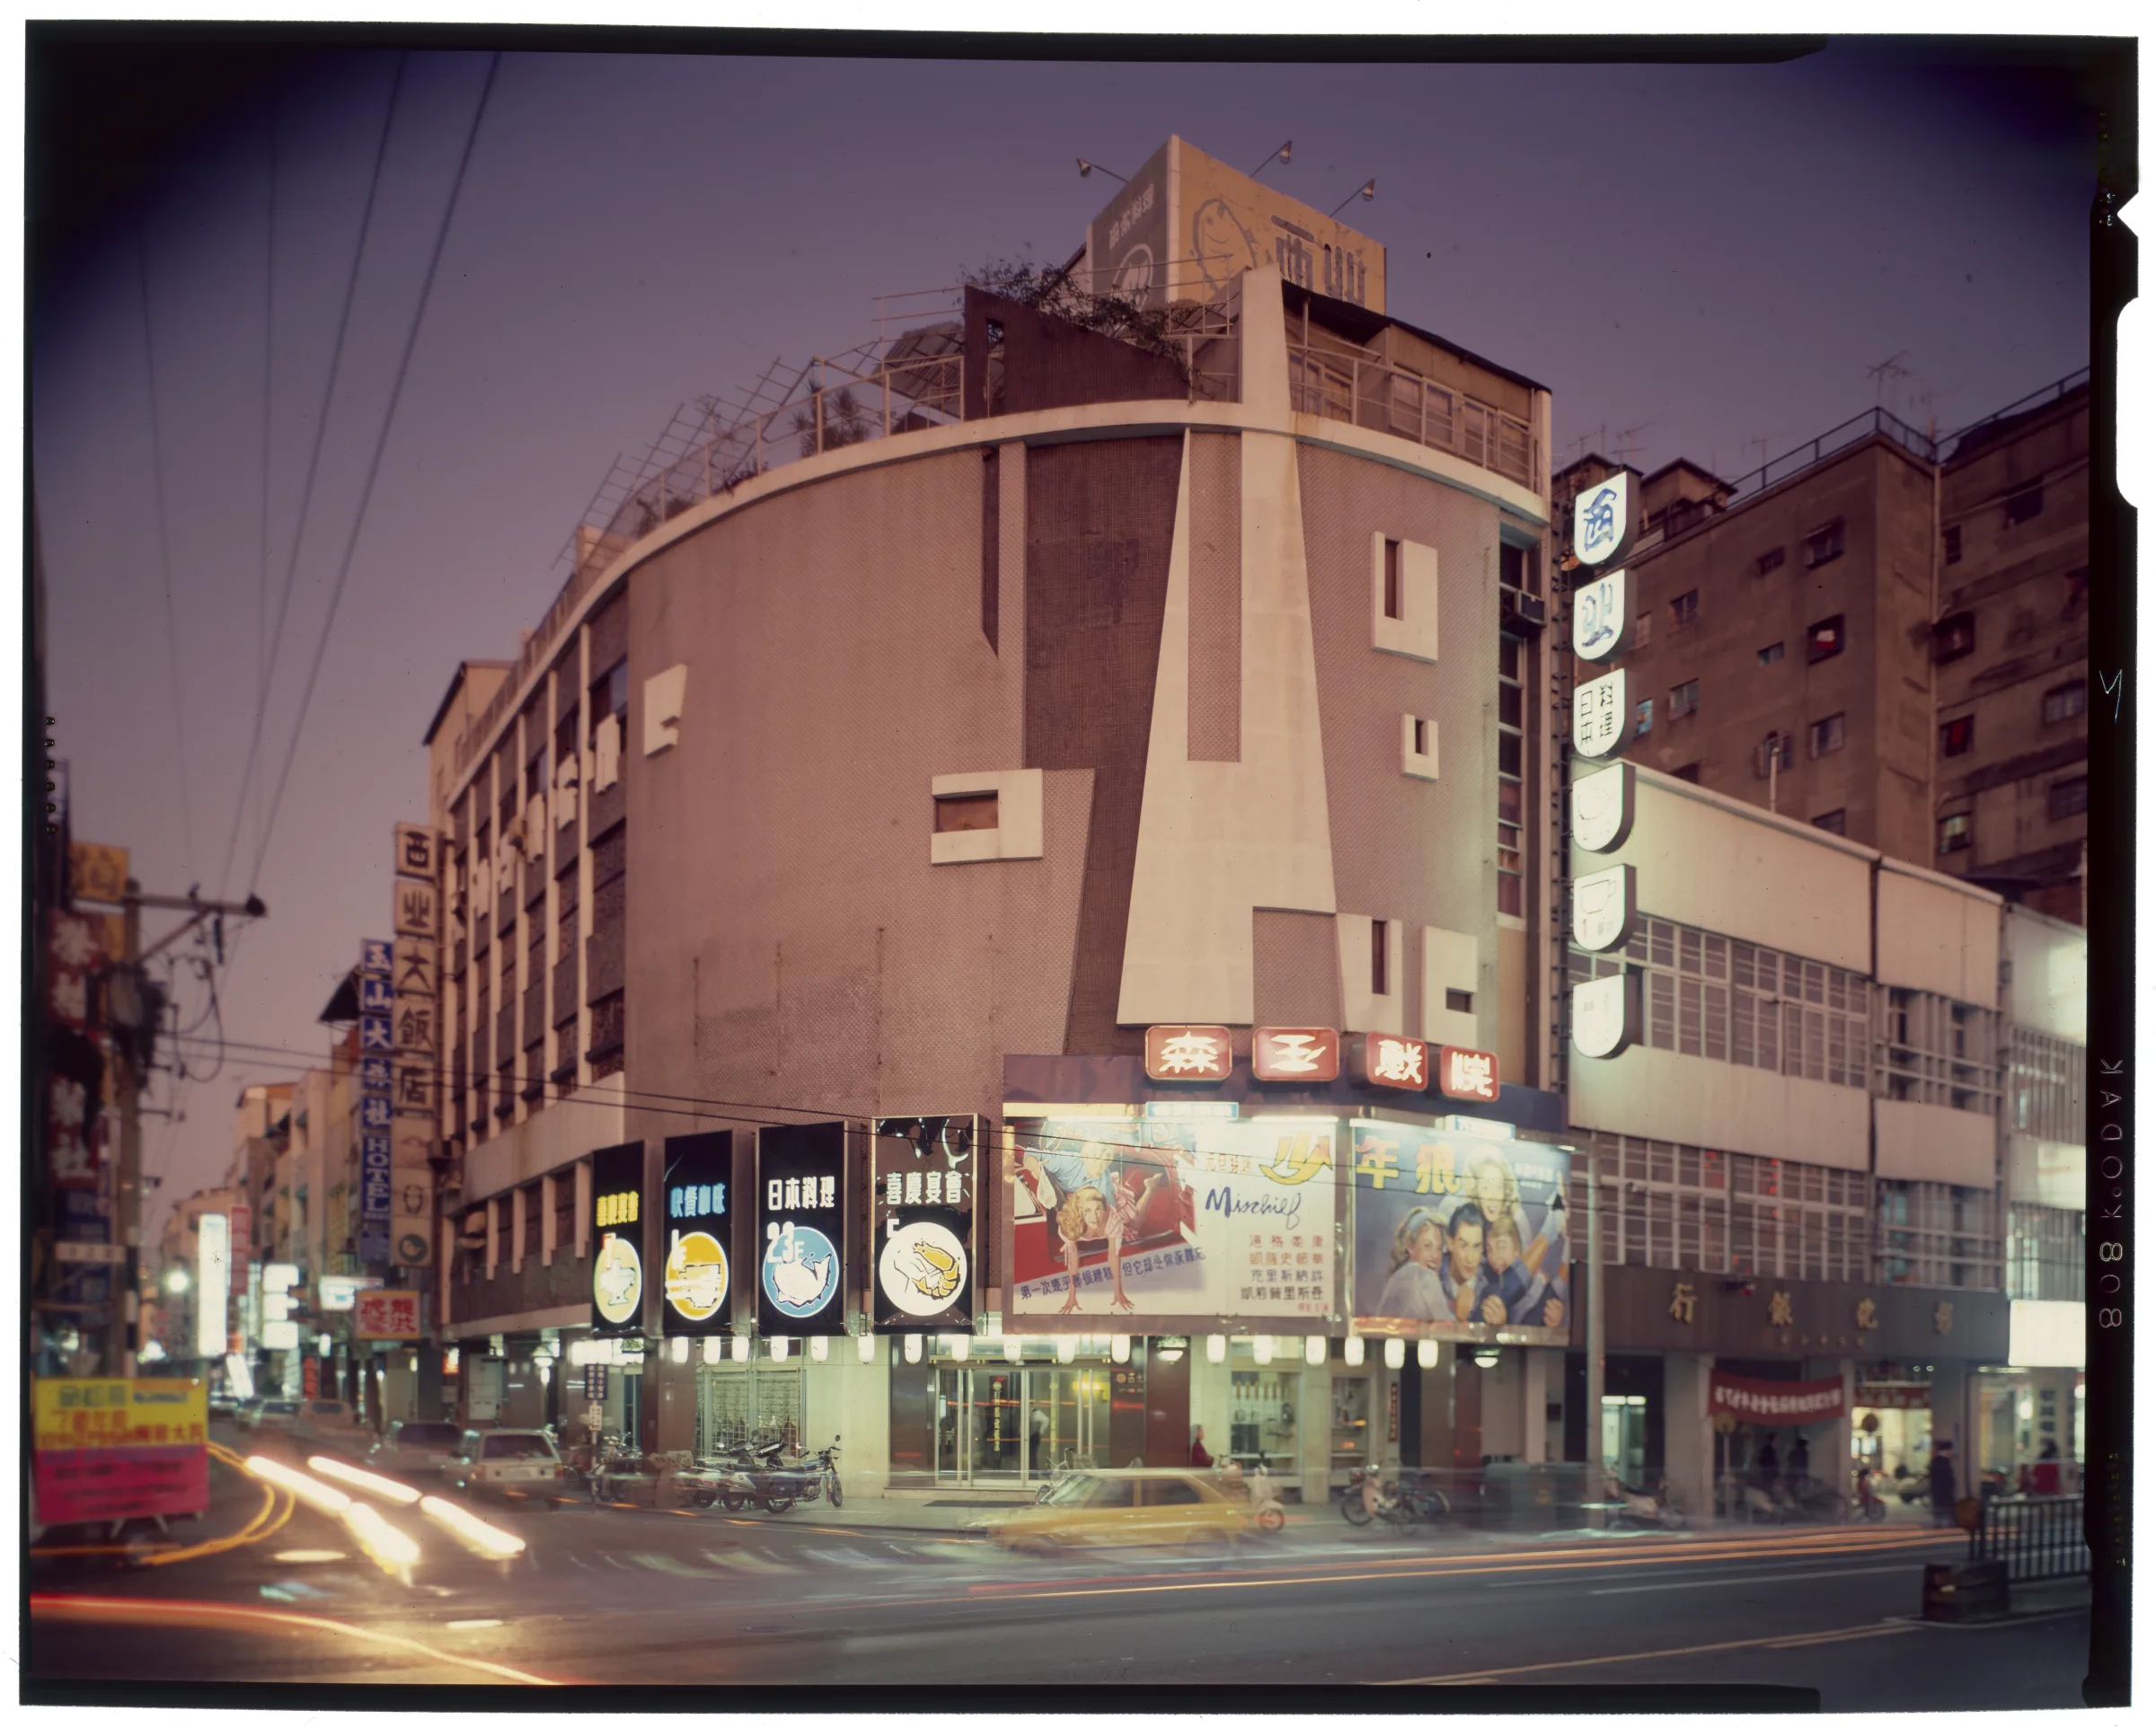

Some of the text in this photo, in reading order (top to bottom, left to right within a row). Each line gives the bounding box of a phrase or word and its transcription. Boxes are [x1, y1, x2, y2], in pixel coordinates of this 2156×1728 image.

[367, 1137, 389, 1212] HOTEL
[768, 1176, 835, 1211] 日本料理
[886, 1169, 962, 1205] 喜慶宴會
[1205, 1186, 1302, 1230] Mischief
